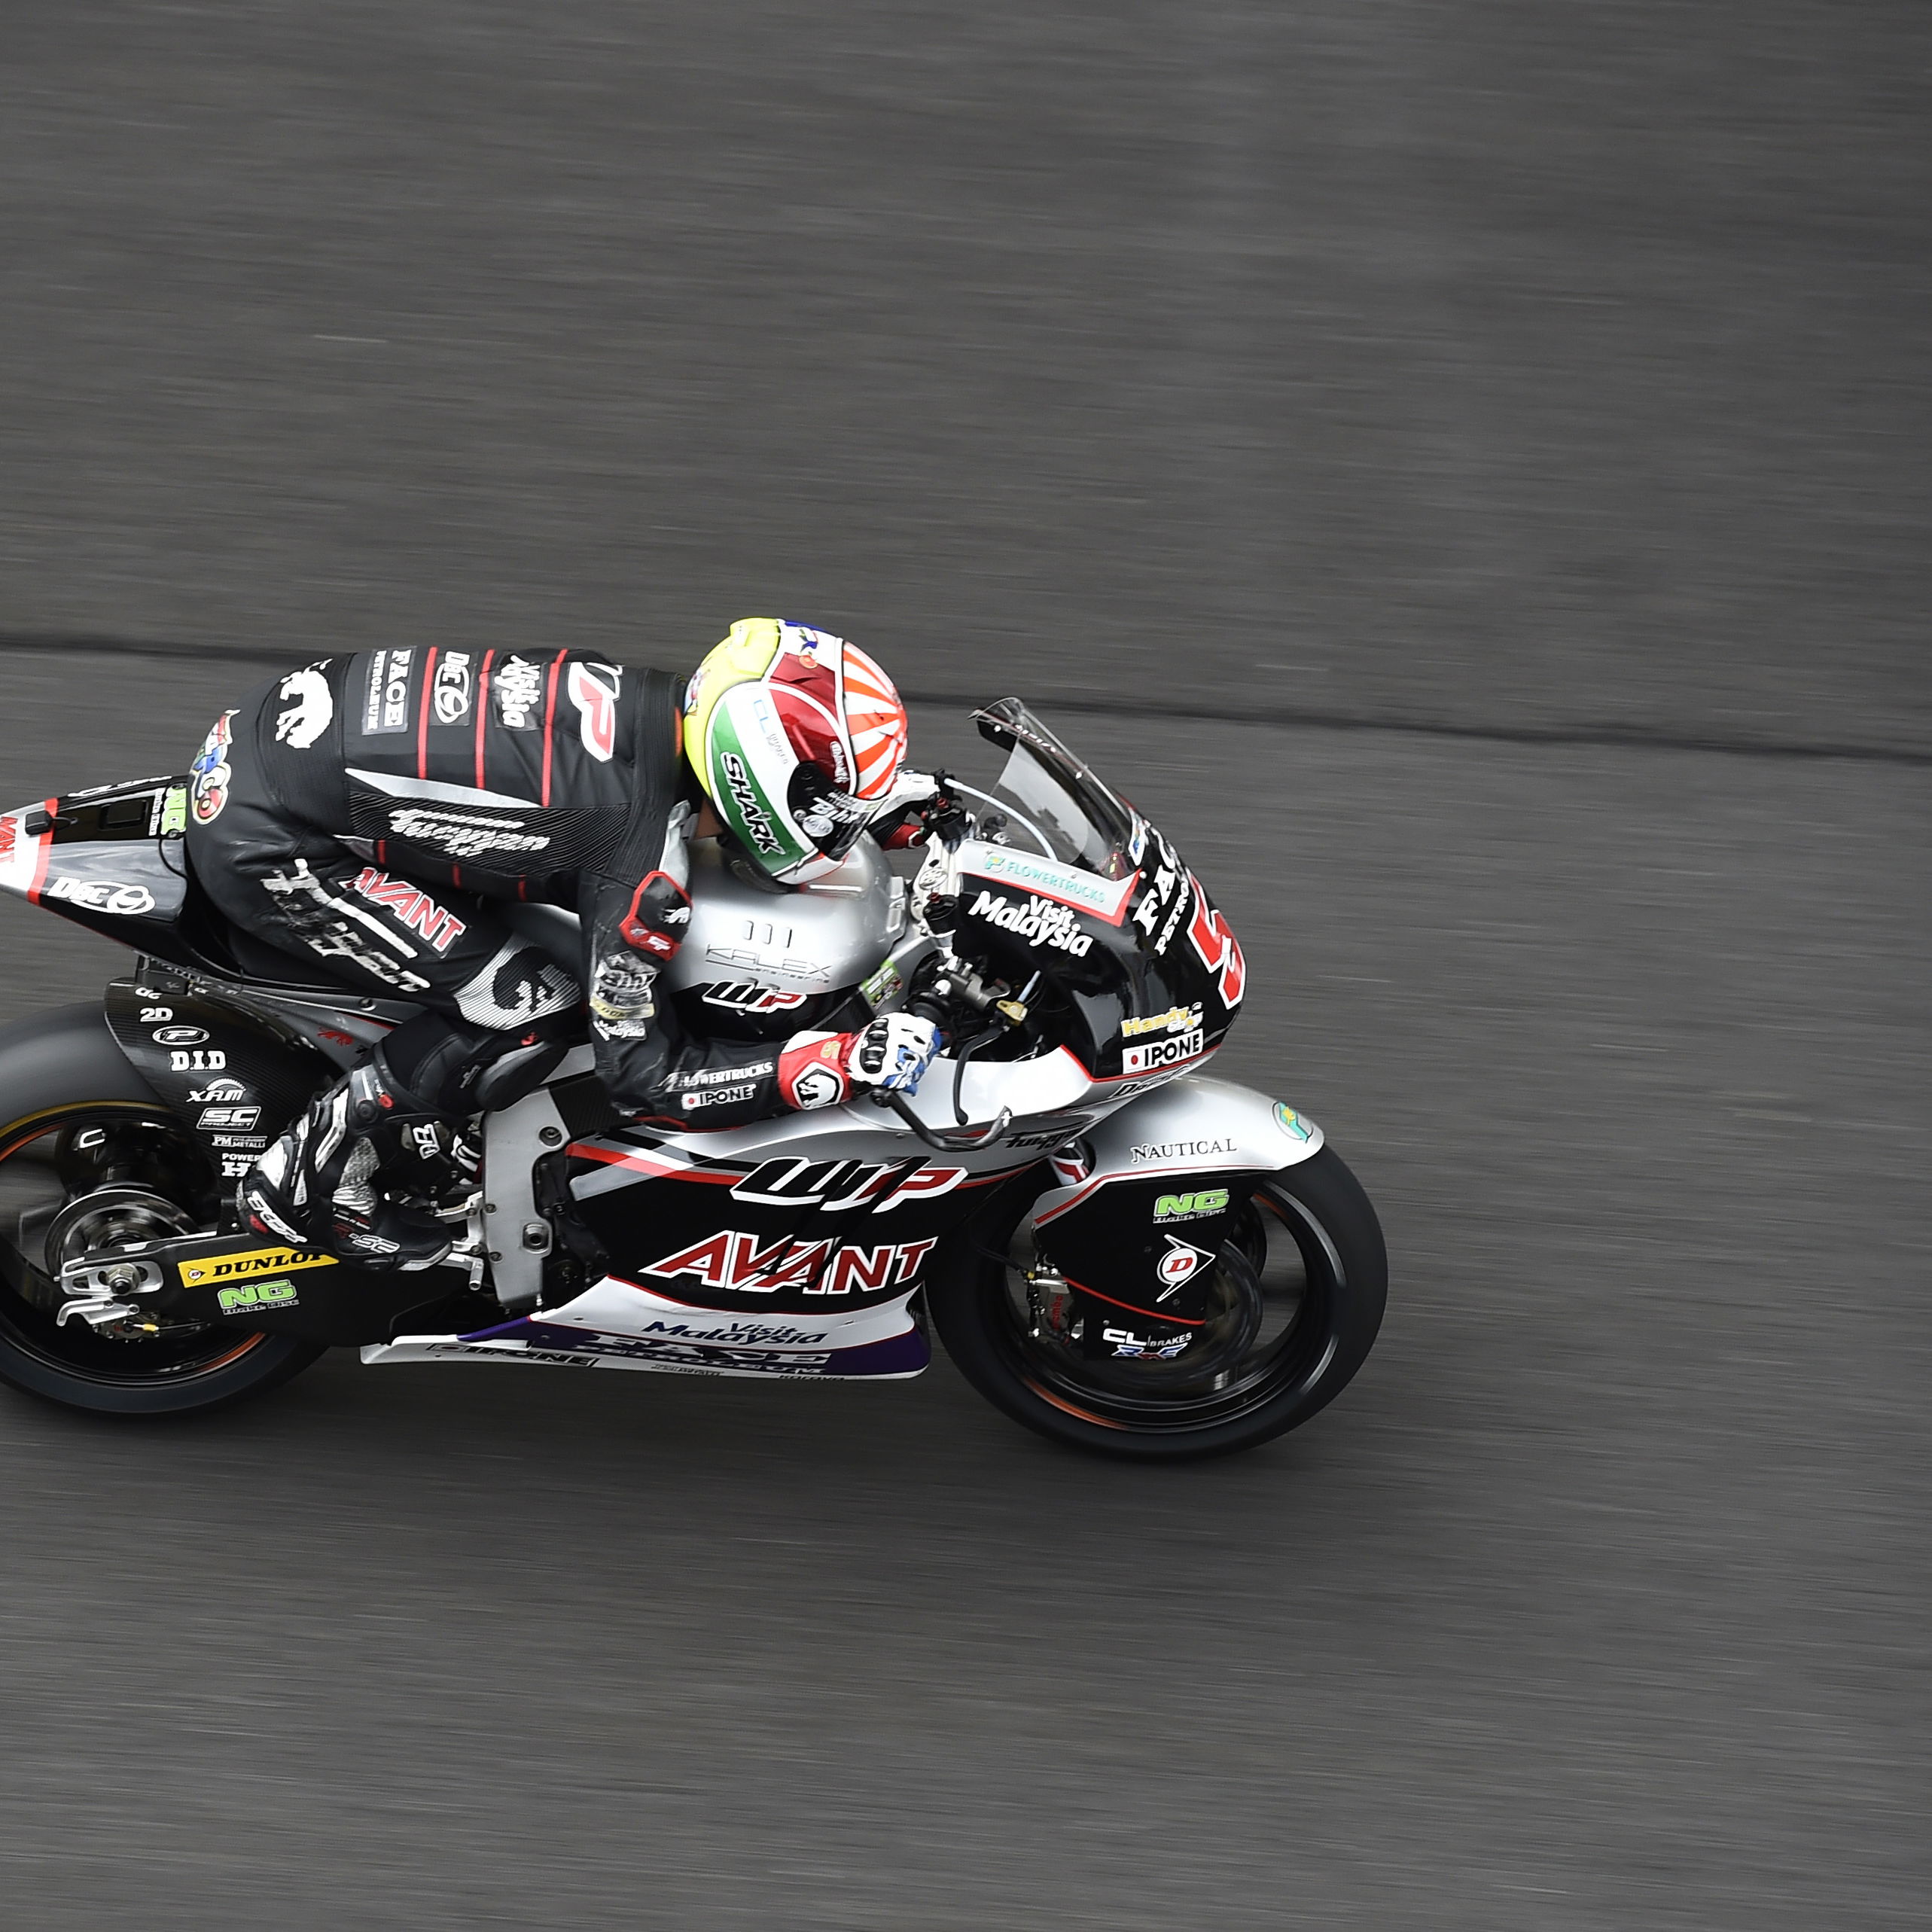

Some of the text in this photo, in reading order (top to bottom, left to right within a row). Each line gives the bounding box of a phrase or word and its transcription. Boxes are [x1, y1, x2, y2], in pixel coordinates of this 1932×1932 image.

[721, 751, 786, 855] SHARK
[1007, 861, 1106, 904] FLOWERTRUCKS
[338, 867, 466, 952] AVANT
[968, 891, 1093, 957] Malaysia
[1029, 894, 1076, 928] Visit
[140, 1007, 173, 1022] 2D
[170, 1050, 226, 1071] D.I.D
[1144, 1034, 1200, 1067] IPONE
[699, 1086, 753, 1105] IPONE
[202, 1109, 257, 1122] SC
[1131, 1138, 1238, 1163] NAUTICAL
[1153, 1188, 1230, 1217] NG
[637, 1230, 939, 1295] AVANT
[218, 1279, 297, 1309] NG
[641, 1321, 829, 1345] Malaysia
[730, 1322, 800, 1336] Visit
[1102, 1328, 1192, 1347] CL BRAKES
